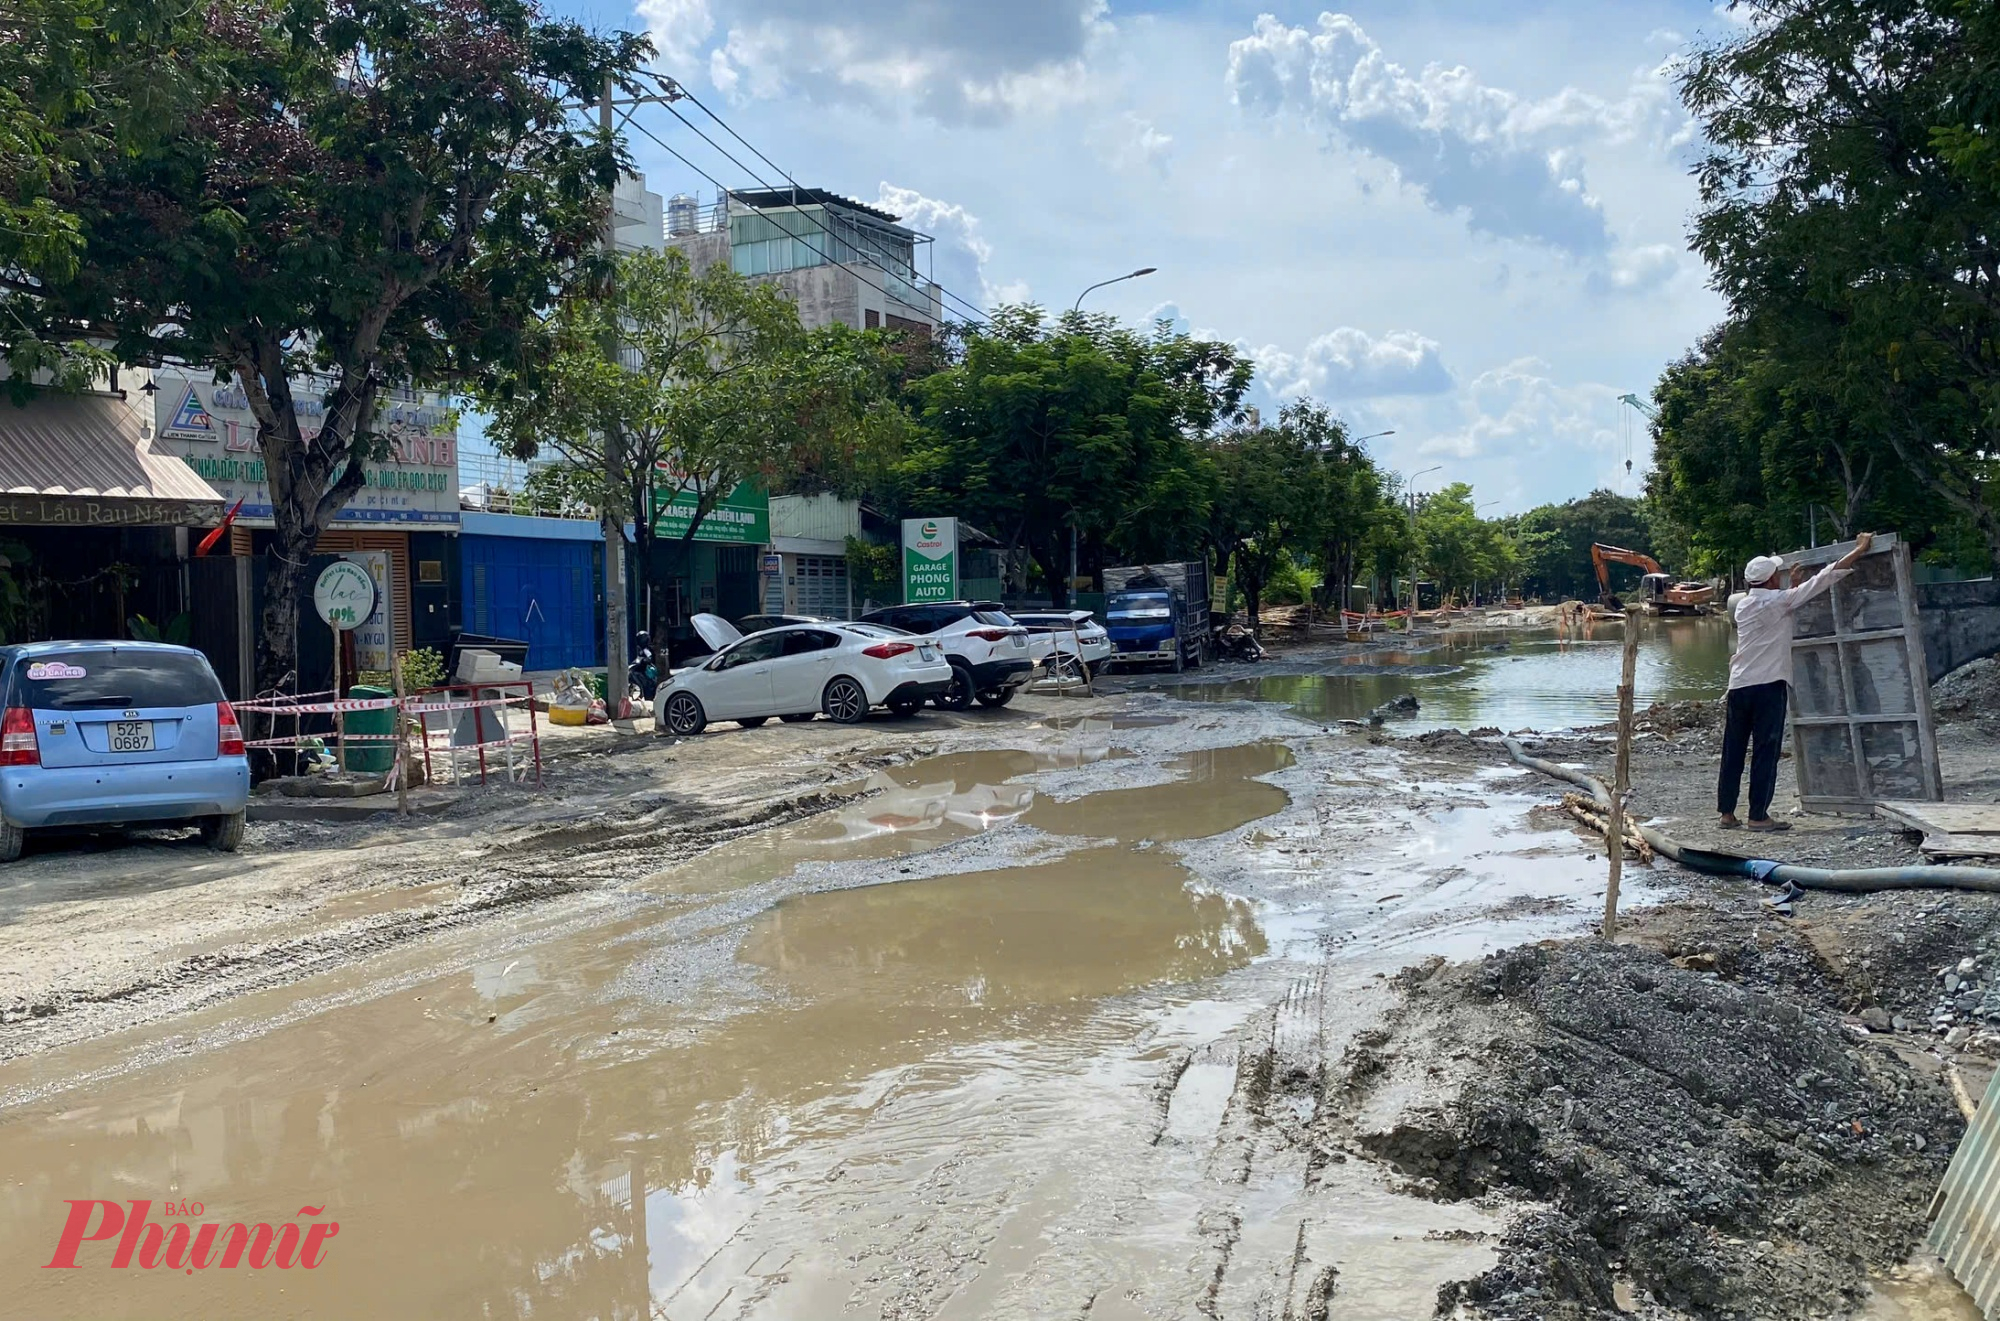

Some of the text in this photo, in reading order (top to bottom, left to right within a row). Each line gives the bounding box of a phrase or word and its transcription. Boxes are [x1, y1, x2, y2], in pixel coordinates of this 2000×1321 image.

[39, 501, 81, 522] Lẩu
[86, 502, 127, 524] Rau
[133, 504, 184, 524] Nấm
[913, 563, 947, 572] GARAGE
[910, 574, 950, 584] PHONG
[915, 586, 946, 597] AUTO
[117, 722, 143, 736] 52F
[114, 736, 149, 750] 0687
